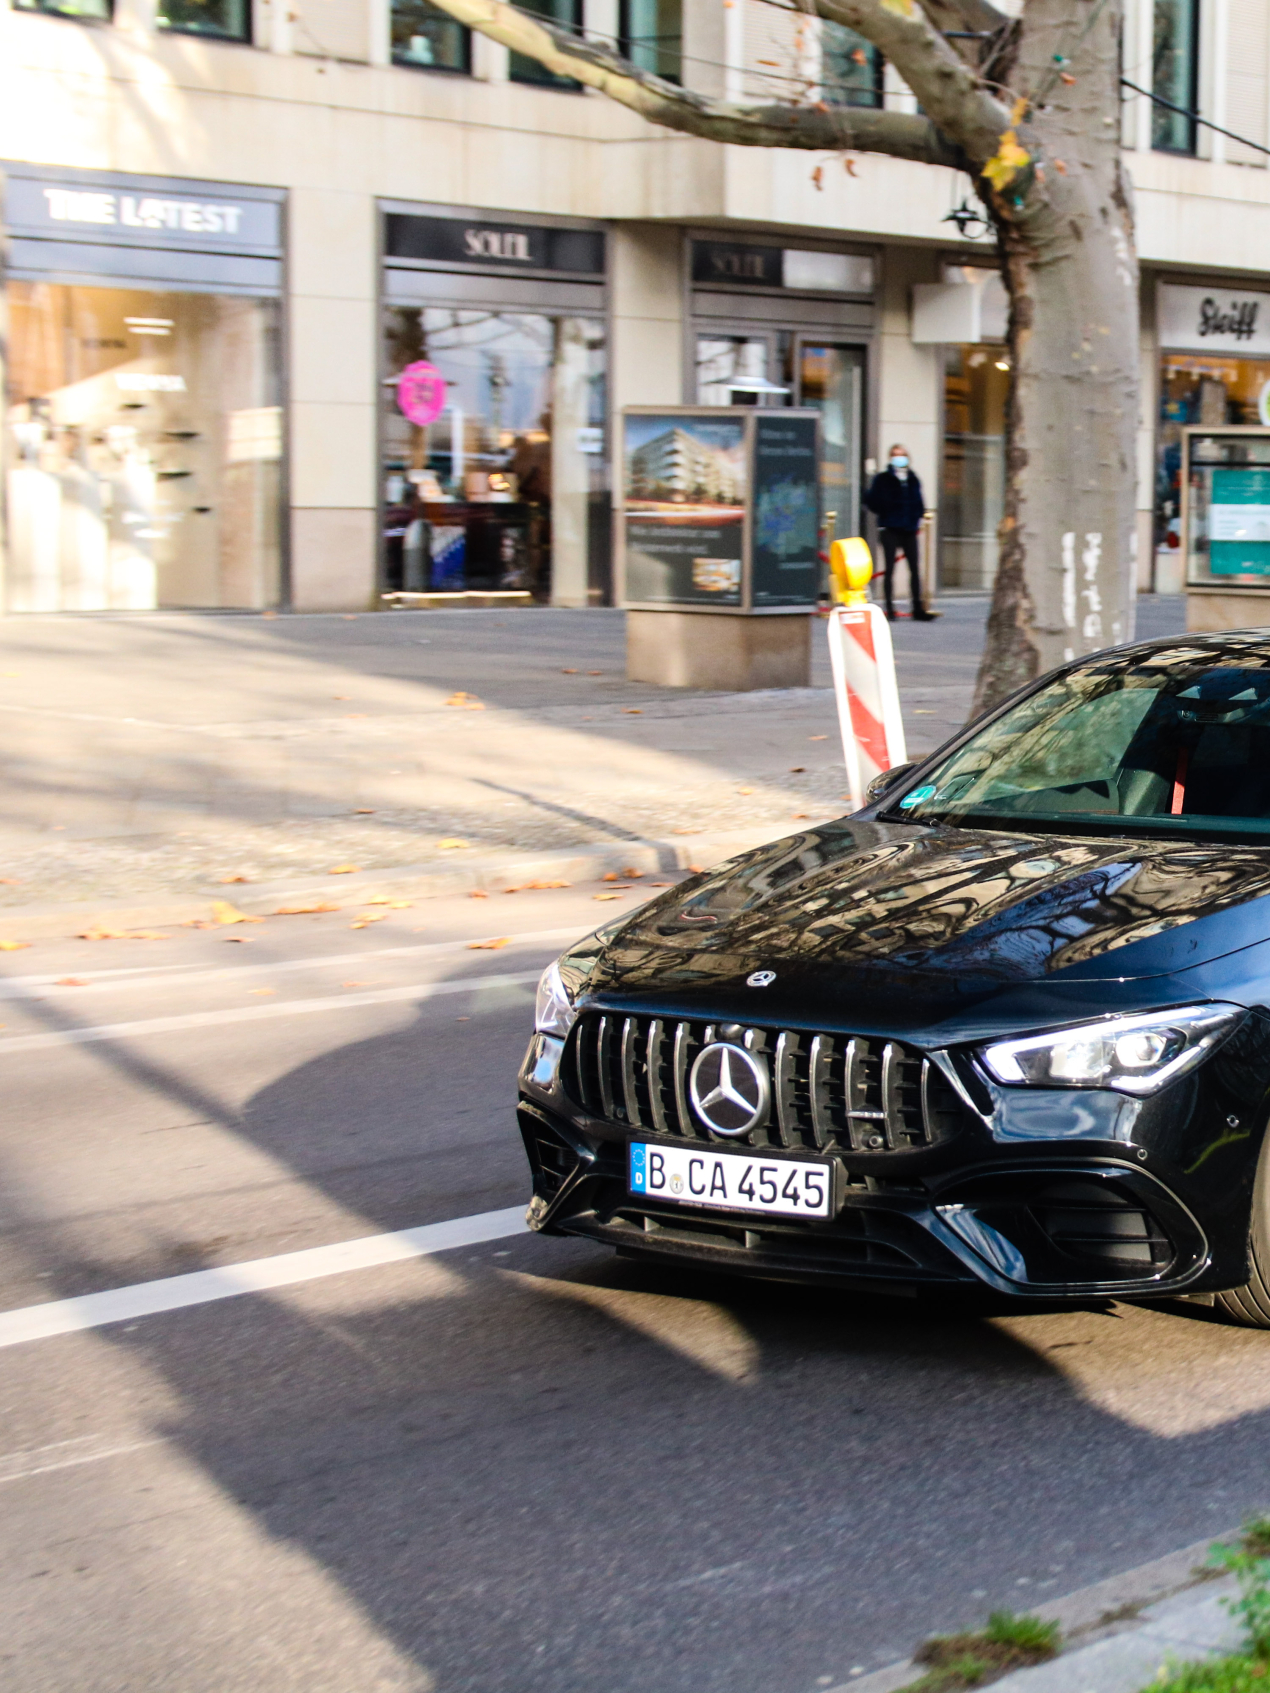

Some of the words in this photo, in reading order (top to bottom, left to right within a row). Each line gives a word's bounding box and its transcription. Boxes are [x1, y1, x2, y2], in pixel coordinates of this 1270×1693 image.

[43, 188, 117, 225] THE
[120, 196, 244, 234] LATEST
[1198, 297, 1260, 340] Steiff
[649, 1152, 667, 1190] B
[688, 1158, 728, 1199] CA
[737, 1164, 825, 1209] 4545
